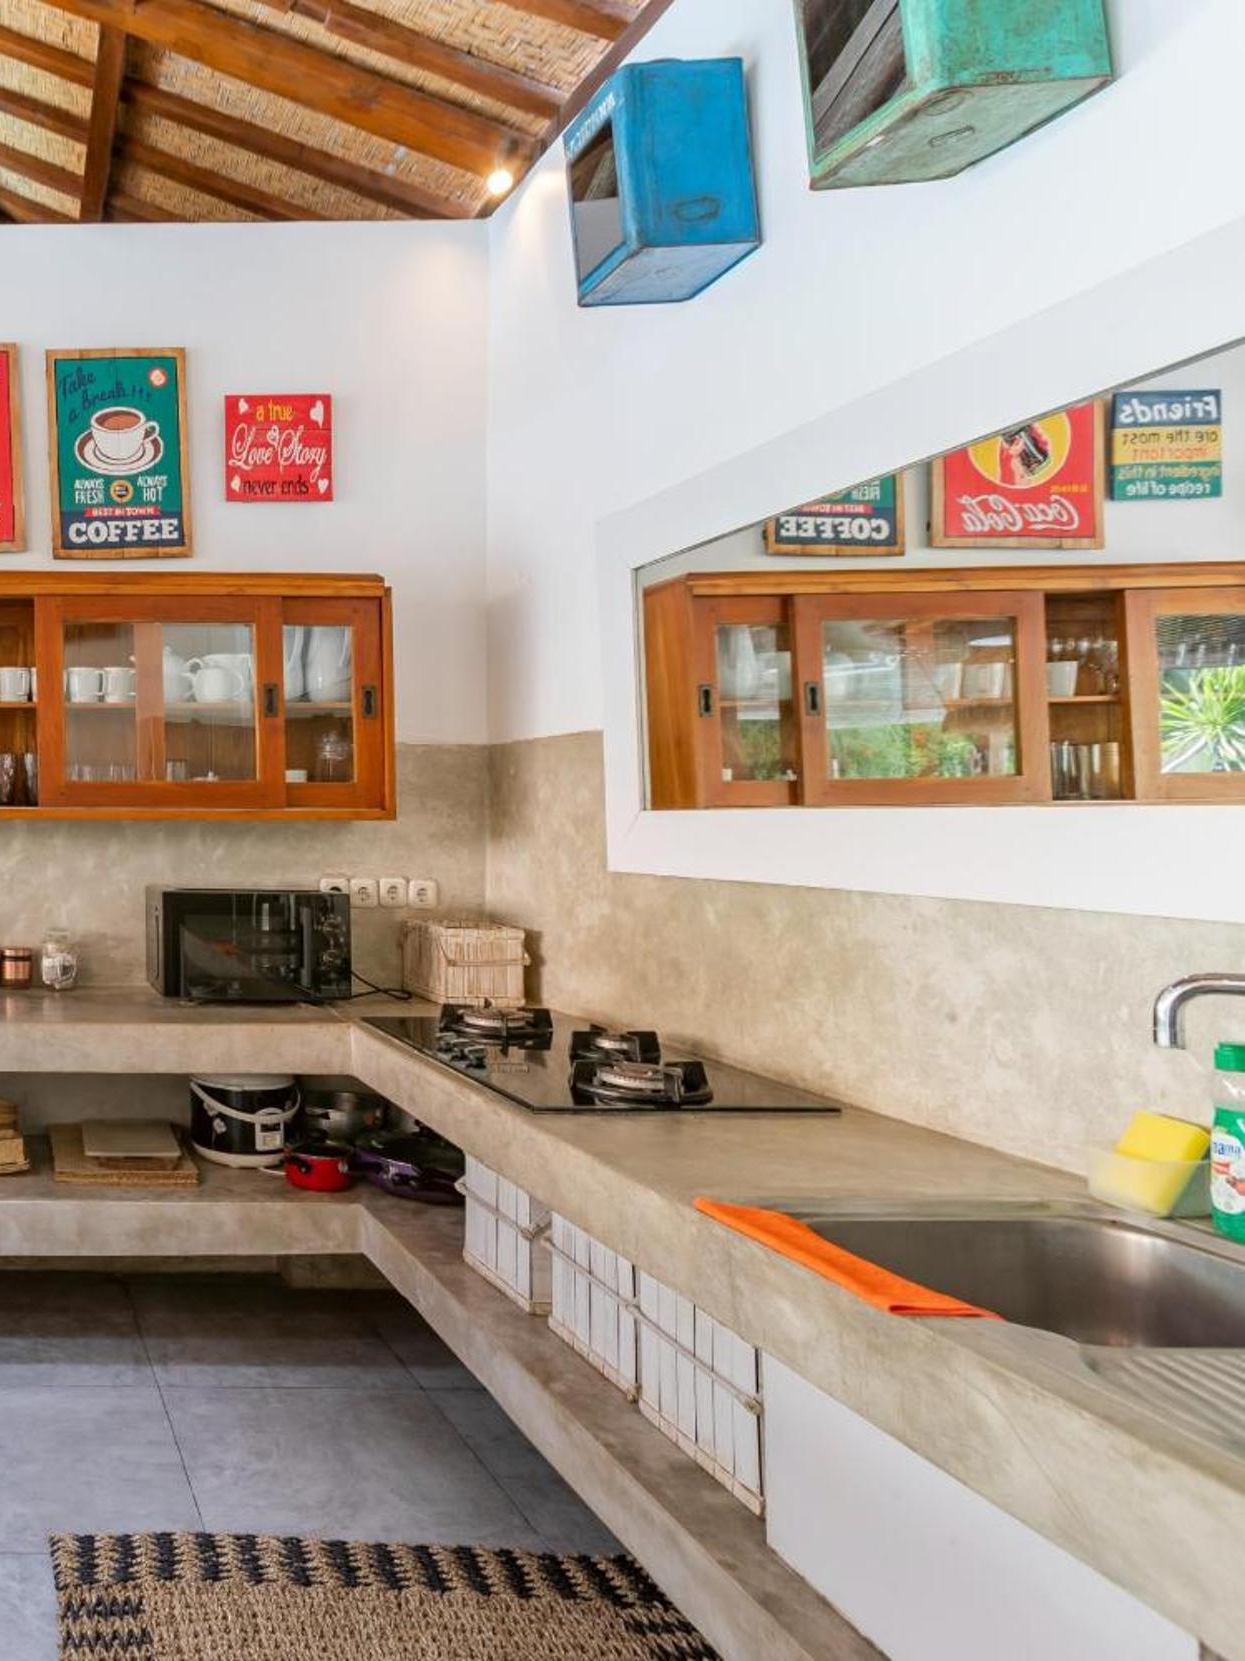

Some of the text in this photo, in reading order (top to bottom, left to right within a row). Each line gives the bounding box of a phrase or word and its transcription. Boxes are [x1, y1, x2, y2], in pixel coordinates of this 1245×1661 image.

[256, 400, 294, 421] a true
[228, 423, 328, 483] Love Story
[74, 479, 105, 490] ALWAYS
[137, 474, 168, 488] ALWAYS
[243, 474, 309, 495] never ends
[75, 490, 105, 504] FRESH
[143, 487, 163, 502] HOT
[92, 507, 113, 517] BEST
[68, 518, 179, 544] COFFEE
